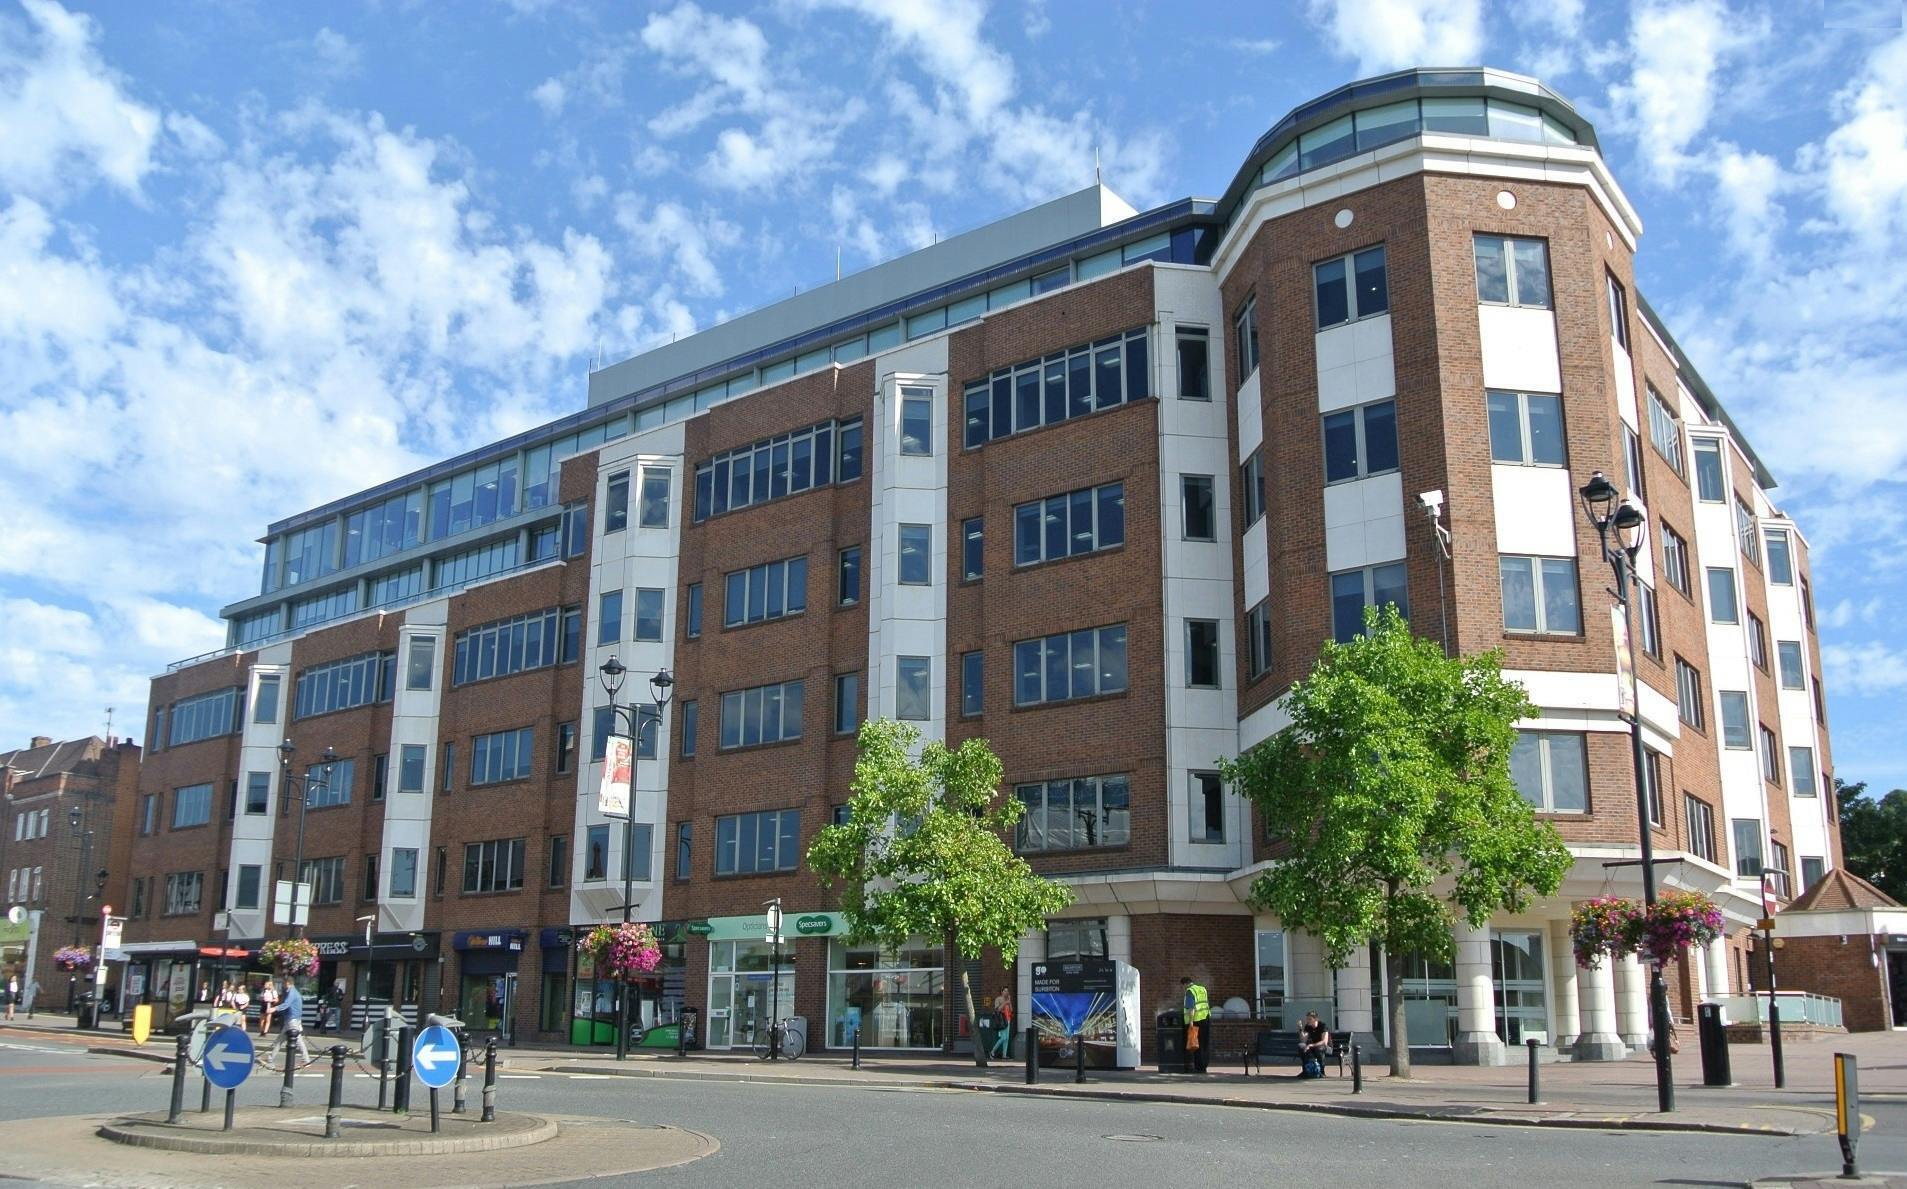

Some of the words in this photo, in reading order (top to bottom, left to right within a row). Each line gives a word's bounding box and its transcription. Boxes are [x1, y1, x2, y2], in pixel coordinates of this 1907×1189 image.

[799, 920, 827, 929] Specsavers
[488, 936, 501, 946] HILL
[1035, 966, 1047, 976] go
